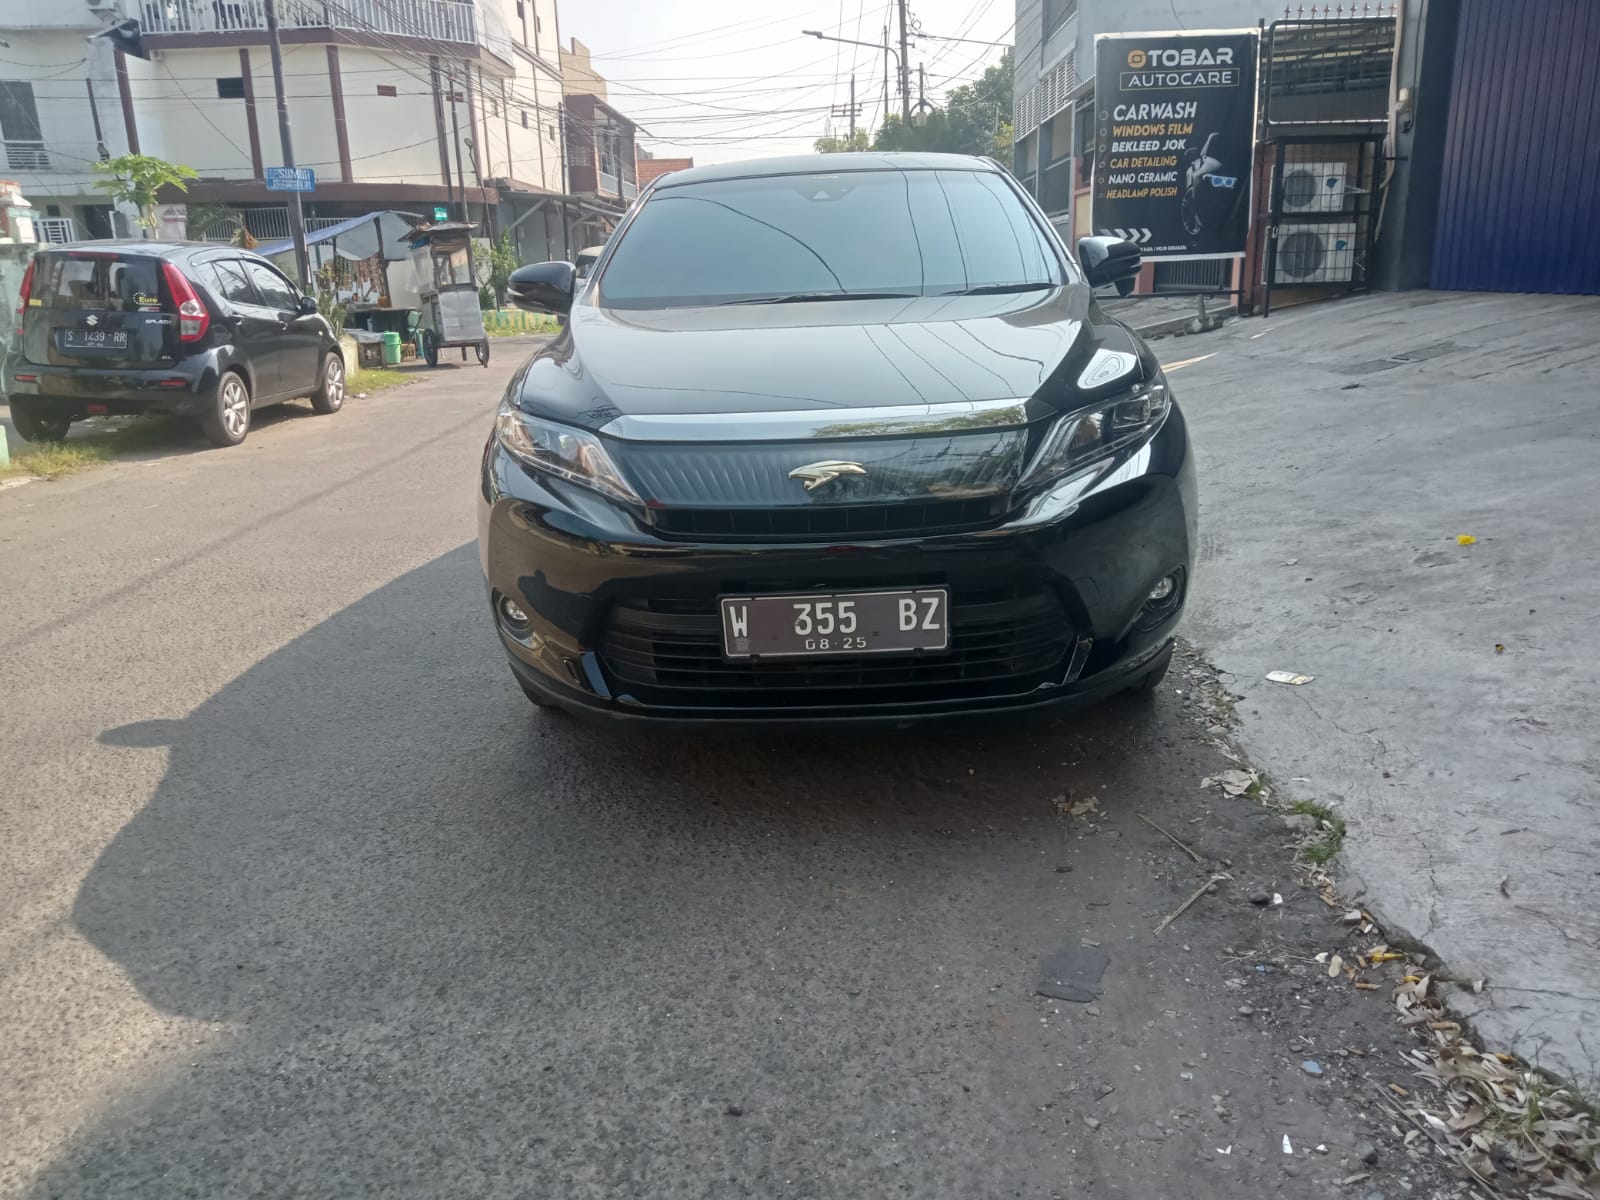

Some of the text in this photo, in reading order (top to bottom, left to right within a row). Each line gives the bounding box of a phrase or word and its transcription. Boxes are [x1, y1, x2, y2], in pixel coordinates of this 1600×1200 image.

[1127, 48, 1234, 69] OTOBAR
[1128, 71, 1233, 88] AUTOCARE
[1113, 102, 1198, 121] CARWASH
[1112, 122, 1194, 137] WINDOWS FILM
[1111, 139, 1187, 153] BEKLEED JOK
[1110, 156, 1177, 169] CAR DETAILING
[1108, 171, 1178, 185] NANO CERAMIC
[1106, 186, 1178, 199] HEADLAMP POLISH
[138, 296, 158, 304] Euro
[67, 330, 126, 343] S 1439 RR
[729, 597, 940, 638] W 355 BZ
